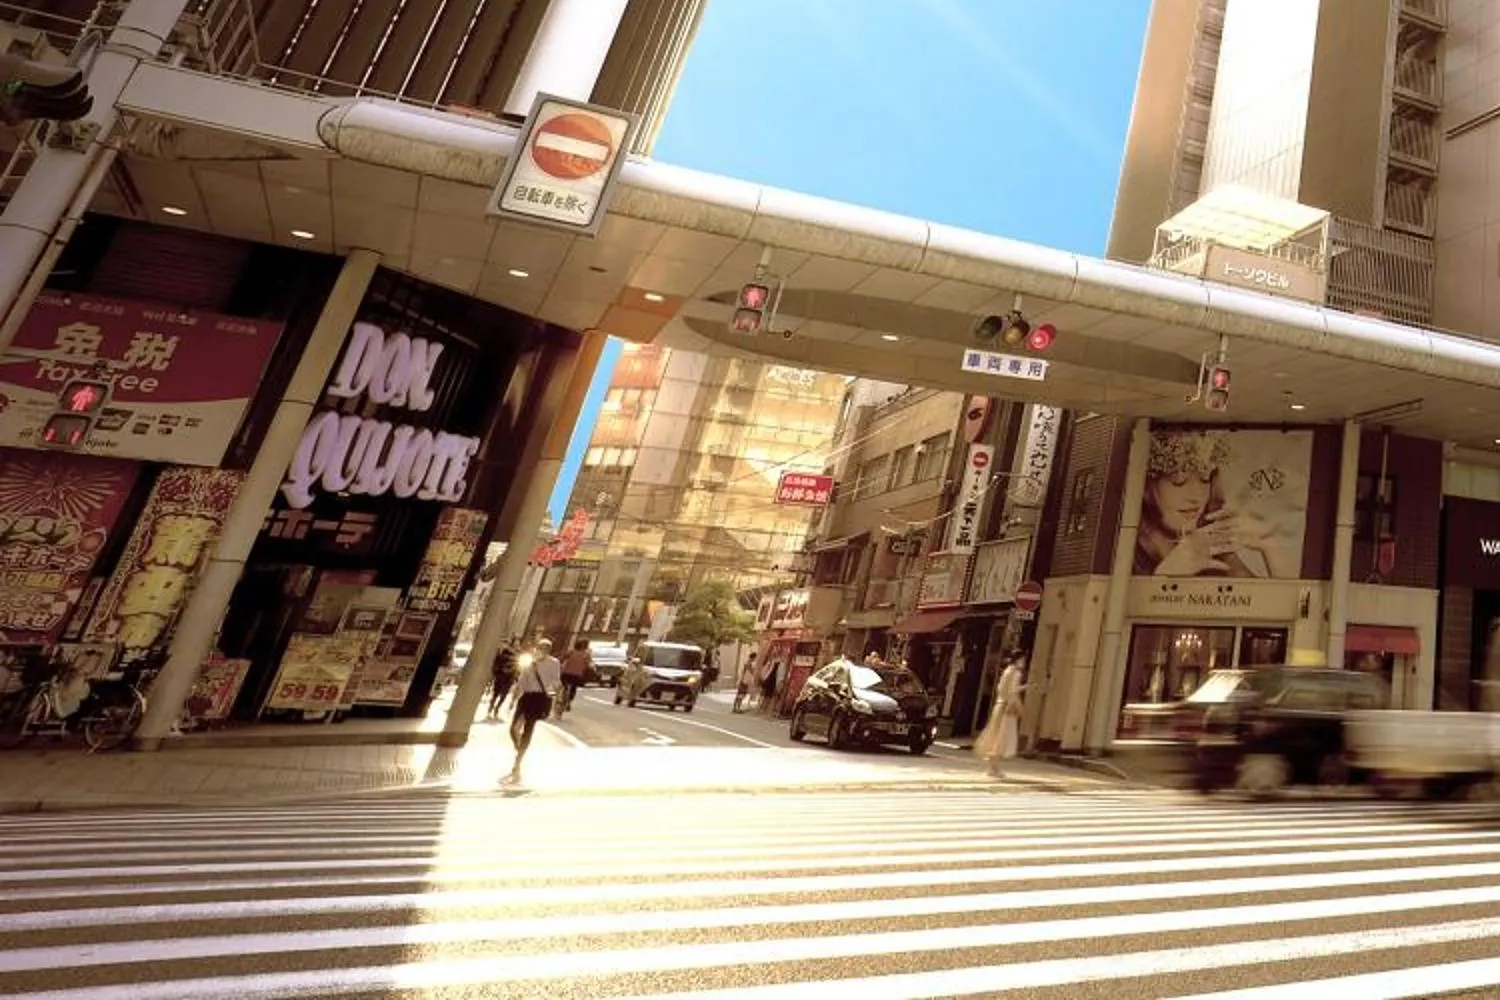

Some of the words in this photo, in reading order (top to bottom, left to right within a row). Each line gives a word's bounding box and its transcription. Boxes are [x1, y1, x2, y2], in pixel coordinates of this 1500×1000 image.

[513, 185, 588, 214] 自転車を除く
[54, 321, 181, 371] 免税
[967, 353, 1043, 377] 車両専用
[35, 359, 91, 382] Tax
[327, 321, 445, 411] DON
[280, 411, 481, 508] QUIJOTE
